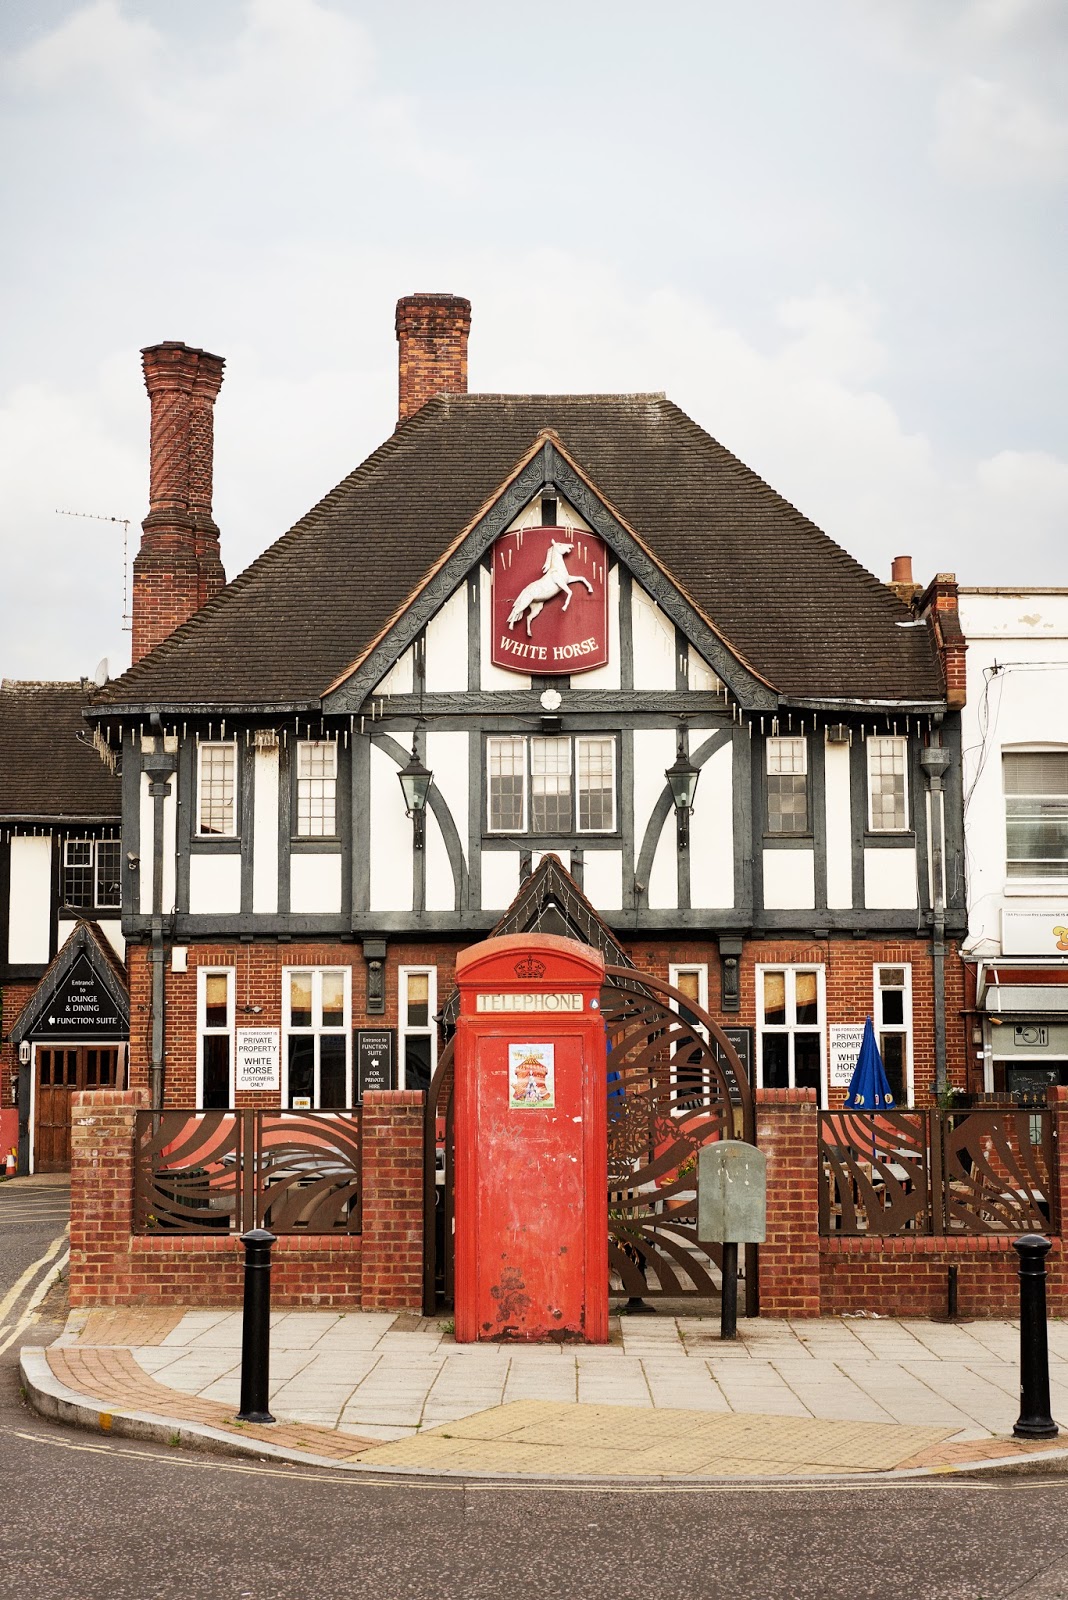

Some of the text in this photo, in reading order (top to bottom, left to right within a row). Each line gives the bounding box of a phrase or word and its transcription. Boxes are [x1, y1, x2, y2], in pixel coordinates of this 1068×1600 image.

[500, 636, 599, 660] WHITE HORSE
[479, 994, 581, 1010] TELEPHONE
[244, 1057, 272, 1065] WHITE
[838, 1053, 859, 1061] WHIT
[243, 1066, 273, 1074] HORSE
